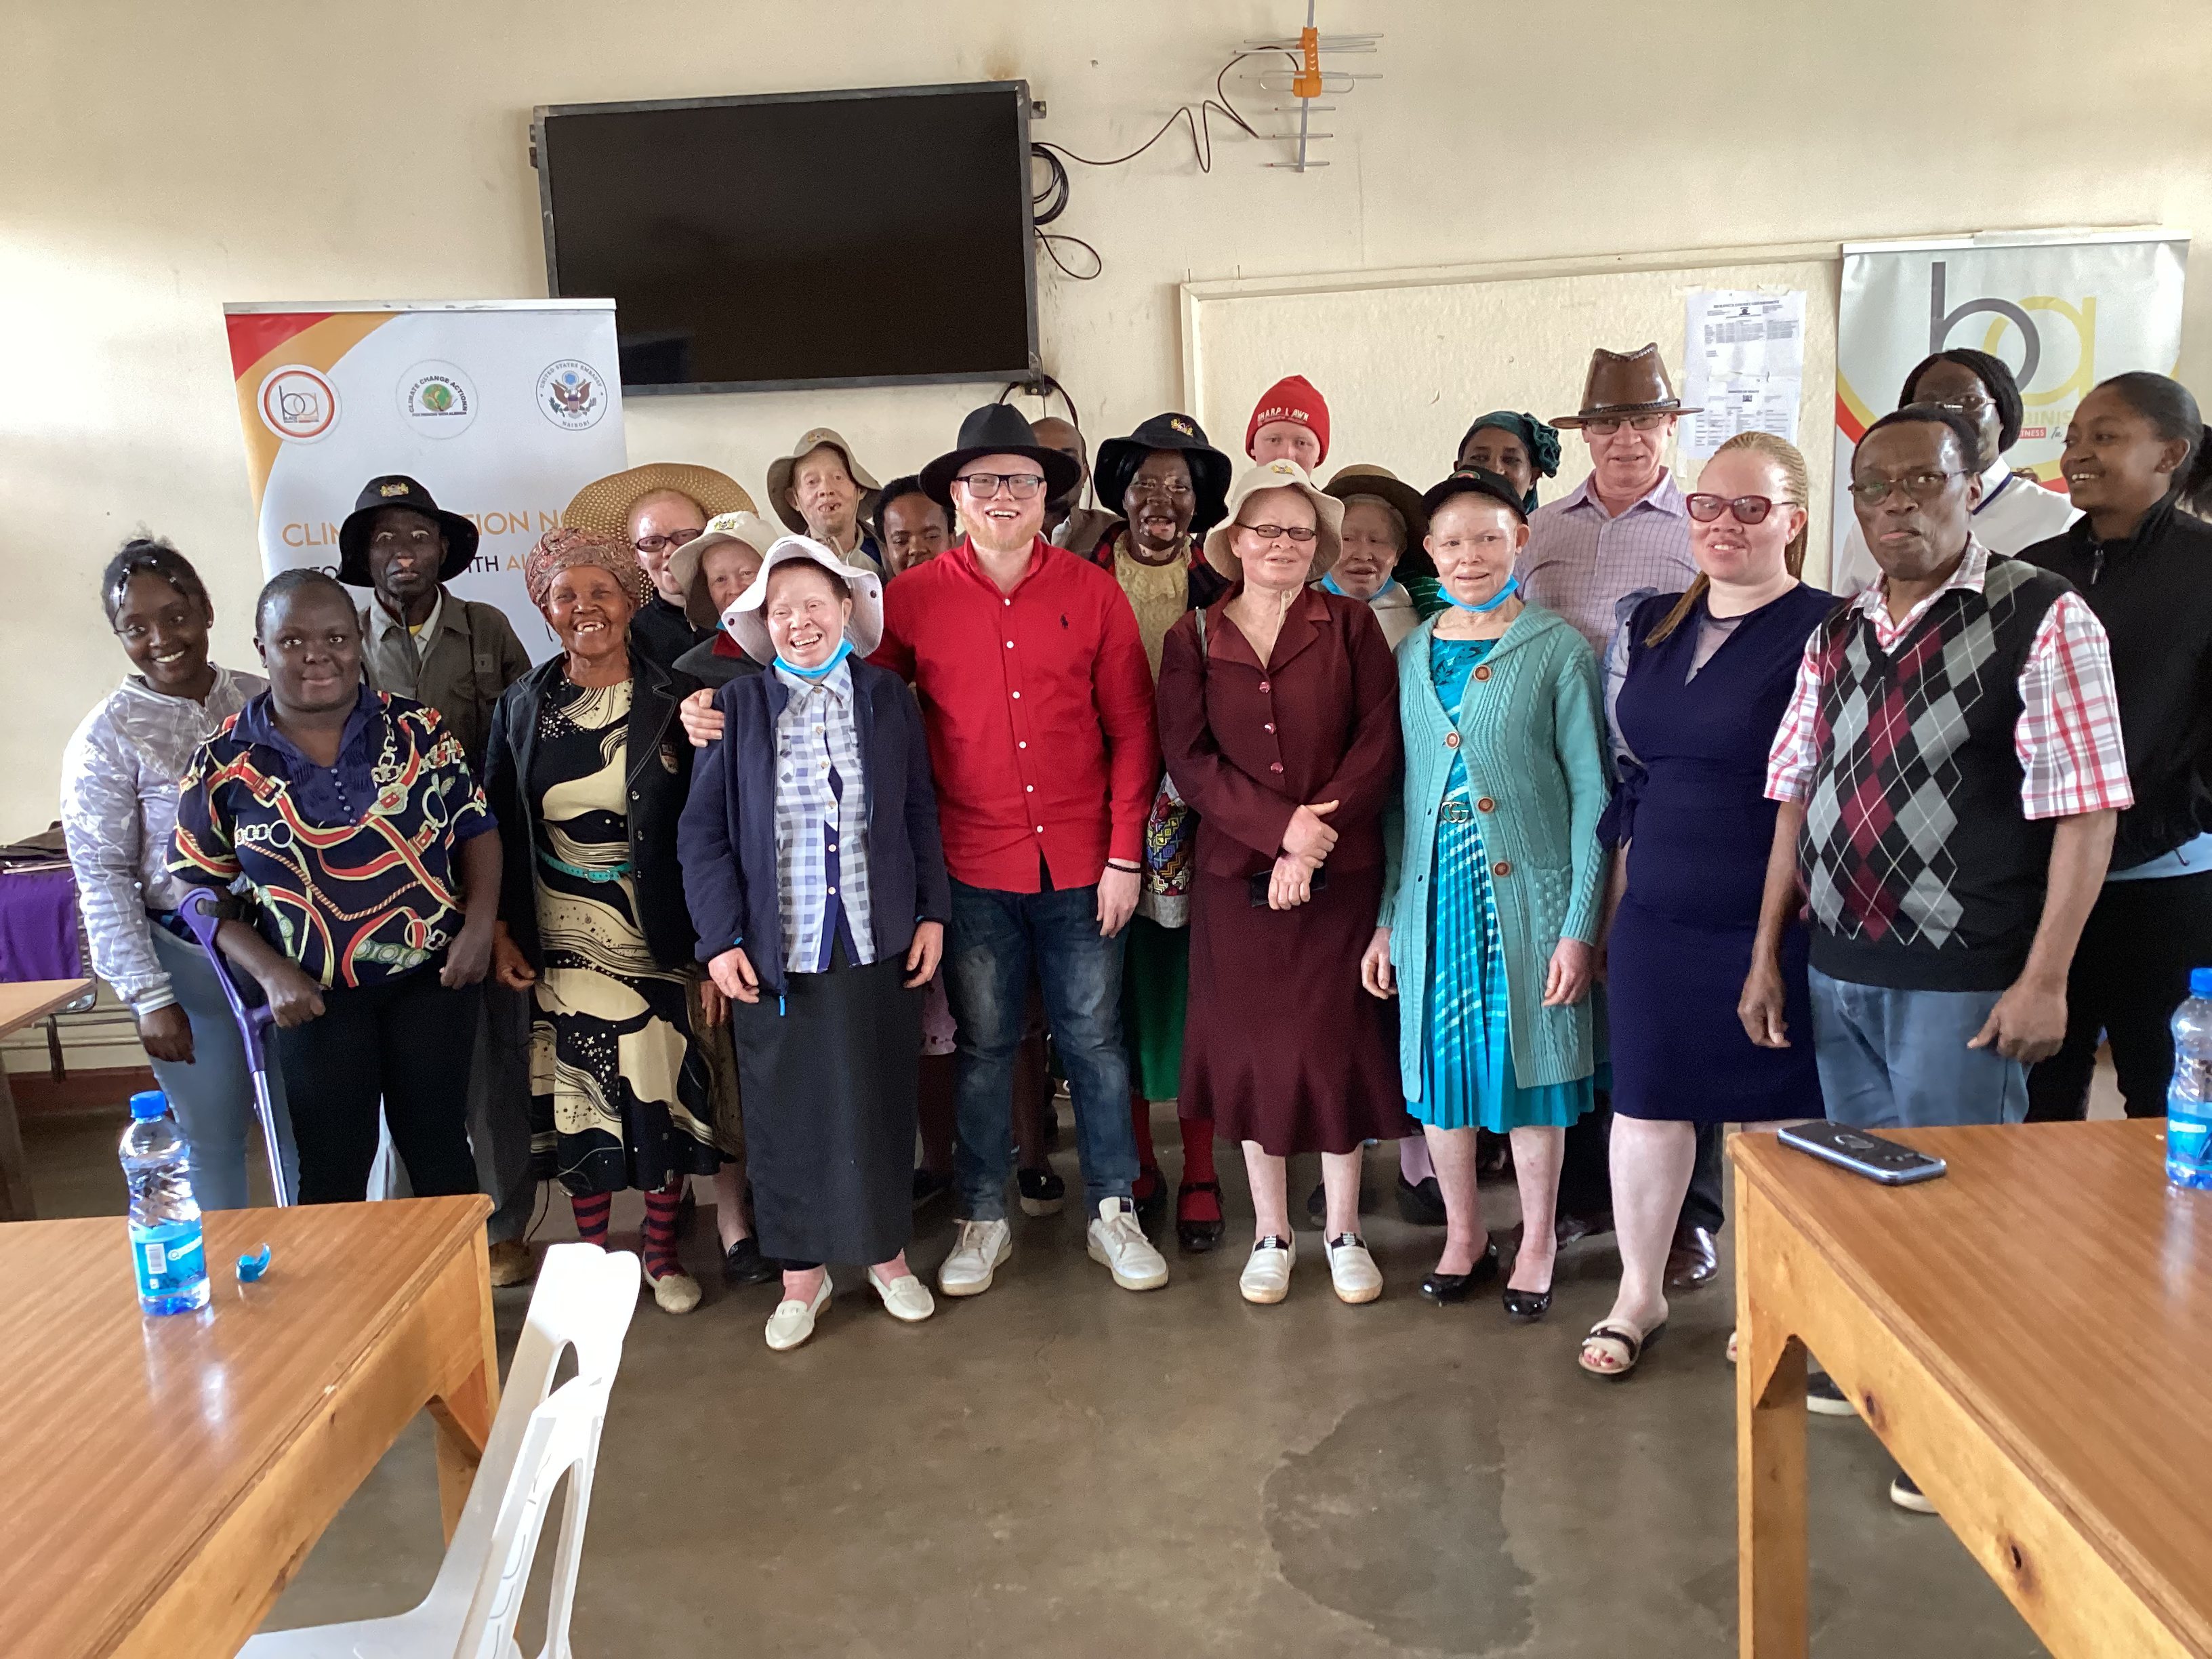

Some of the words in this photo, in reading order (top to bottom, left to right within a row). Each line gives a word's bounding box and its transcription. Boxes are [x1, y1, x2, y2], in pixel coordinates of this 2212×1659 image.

[580, 365, 602, 387] EMBASSY
[408, 383, 420, 413] CLIMATE
[419, 375, 449, 384] CHANGE
[562, 420, 590, 428] NAIROBI
[2021, 429, 2045, 437] TNESS
